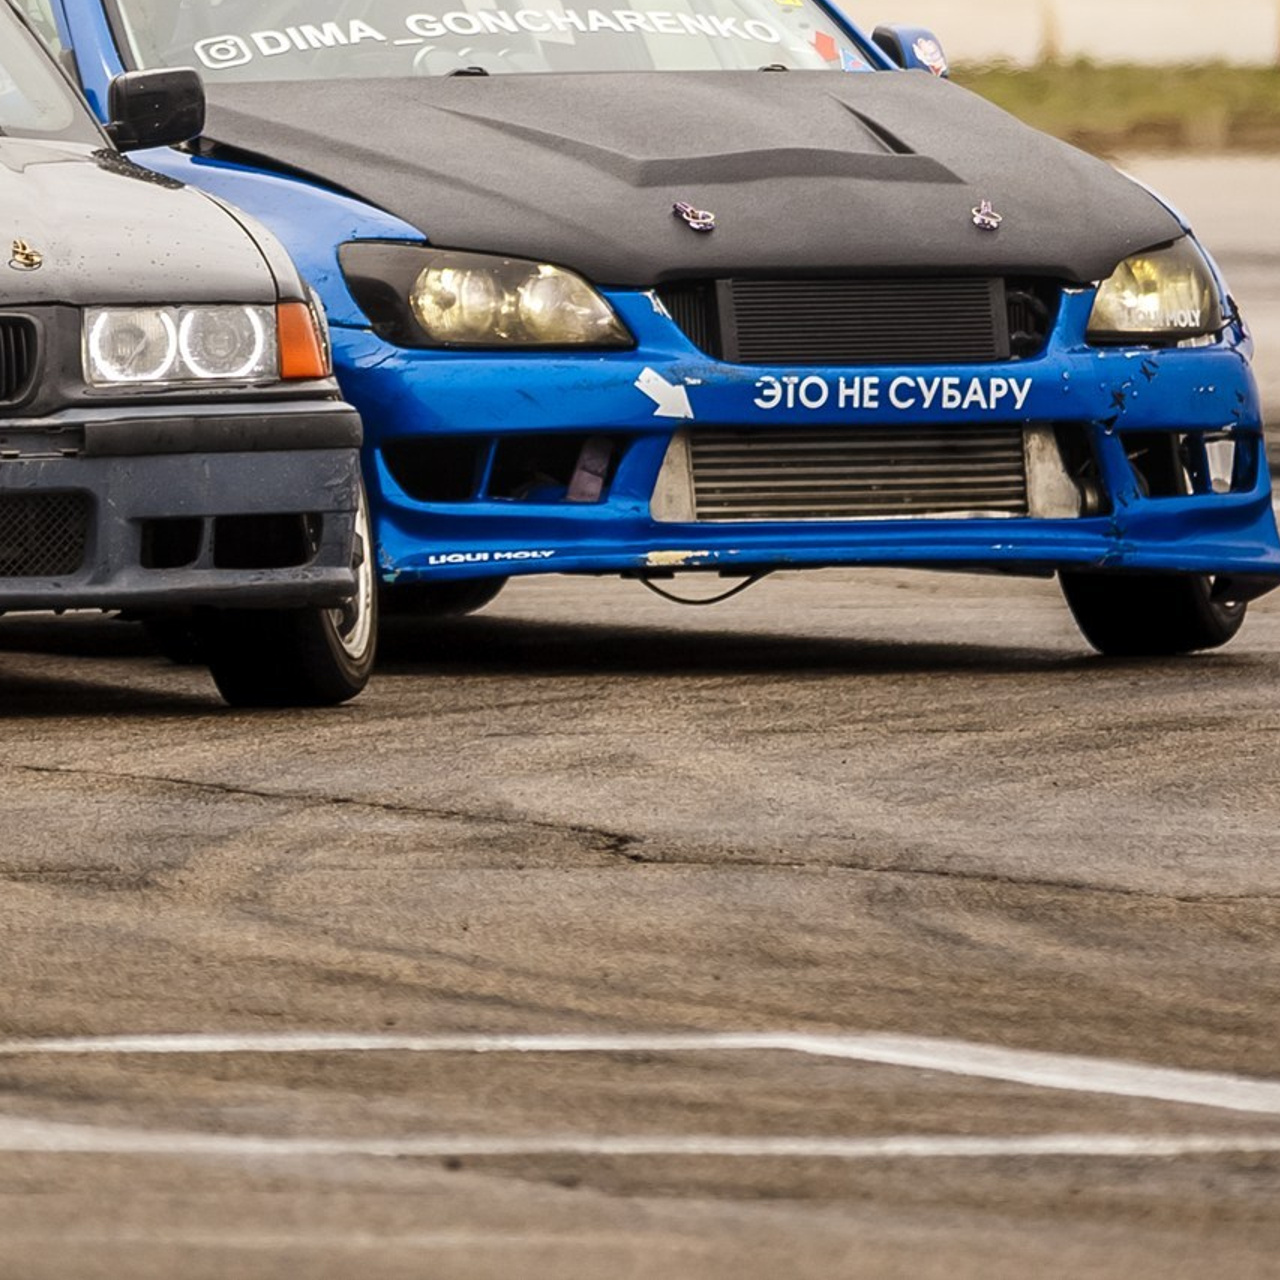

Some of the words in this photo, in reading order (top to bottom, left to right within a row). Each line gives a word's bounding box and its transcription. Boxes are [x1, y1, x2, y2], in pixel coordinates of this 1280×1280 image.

[1166, 308, 1200, 328] MOLY
[753, 375, 829, 409] ЭТО
[838, 376, 880, 409] НЕ
[888, 376, 1033, 410] СУБАРУ
[428, 552, 490, 565] LIQUI
[493, 550, 556, 560] MOLY
